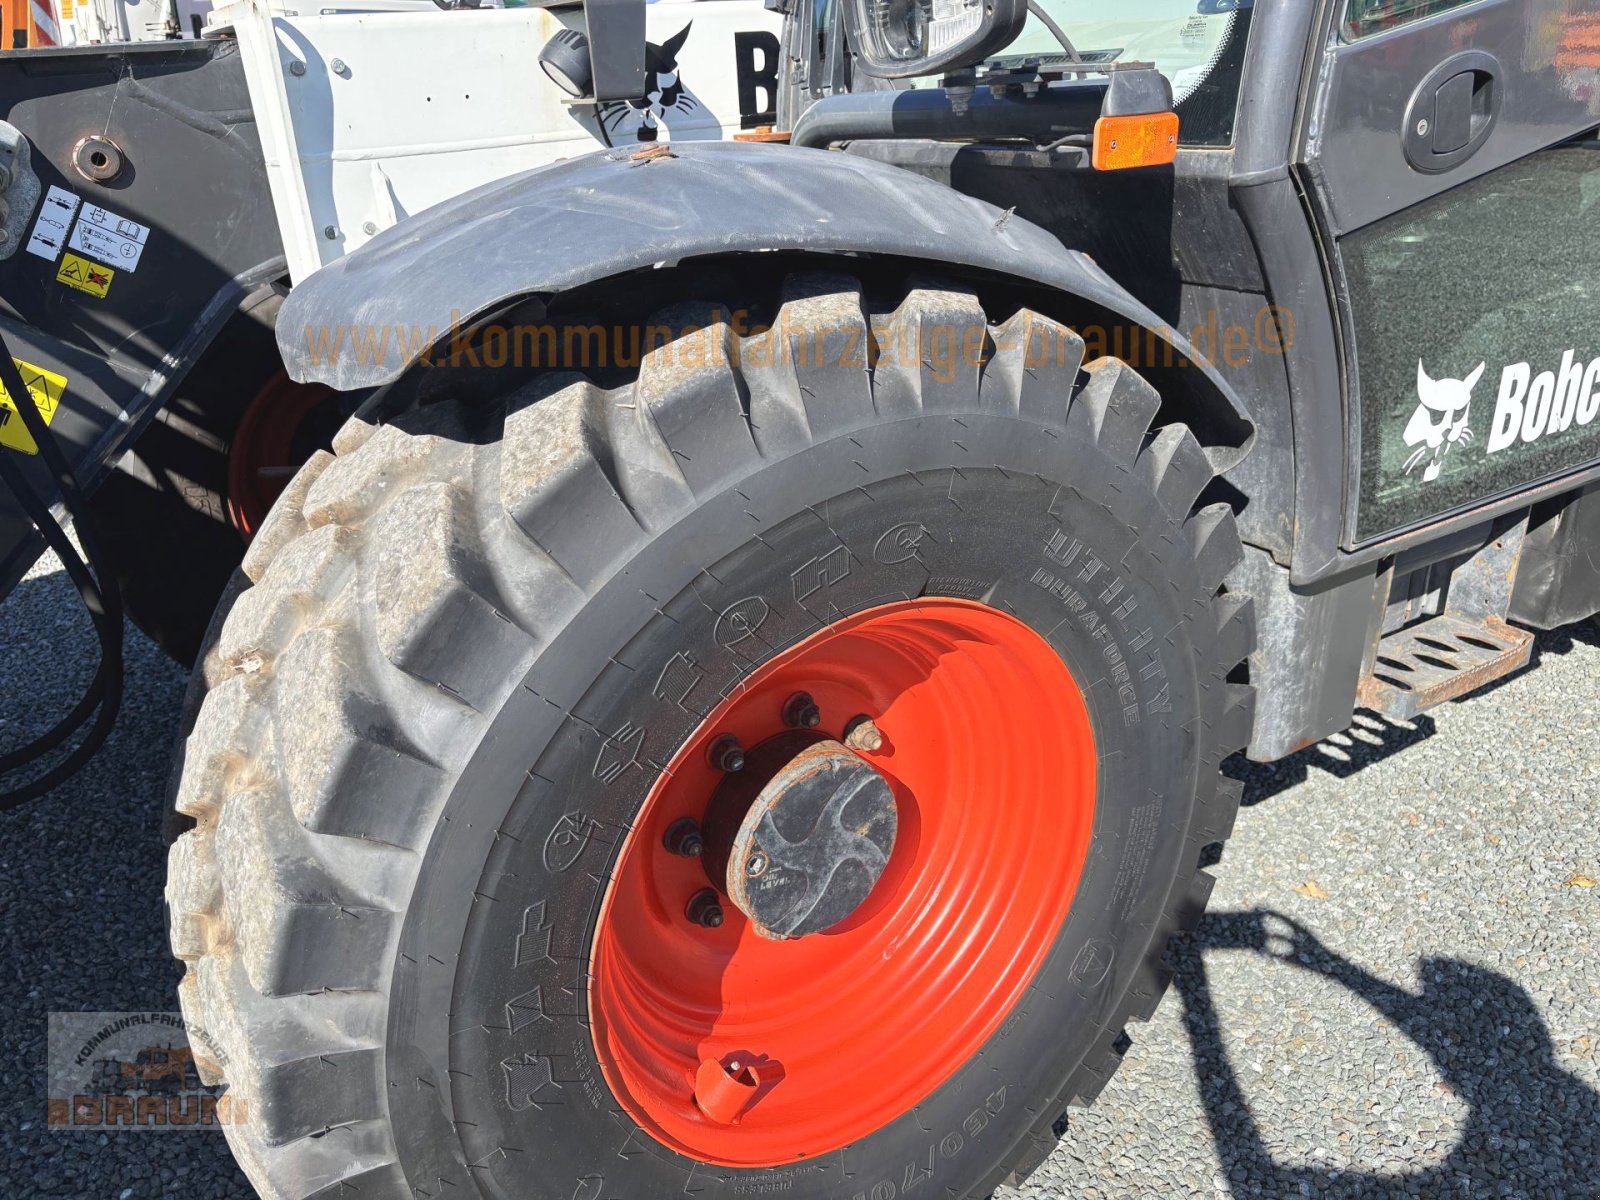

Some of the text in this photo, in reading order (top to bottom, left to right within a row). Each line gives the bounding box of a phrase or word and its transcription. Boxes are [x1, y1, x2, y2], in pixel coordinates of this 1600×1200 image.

[1030, 567, 1141, 727] DURAFORCE
[1043, 528, 1173, 716] UTILITY
[853, 1086, 1008, 1200] 460/70
